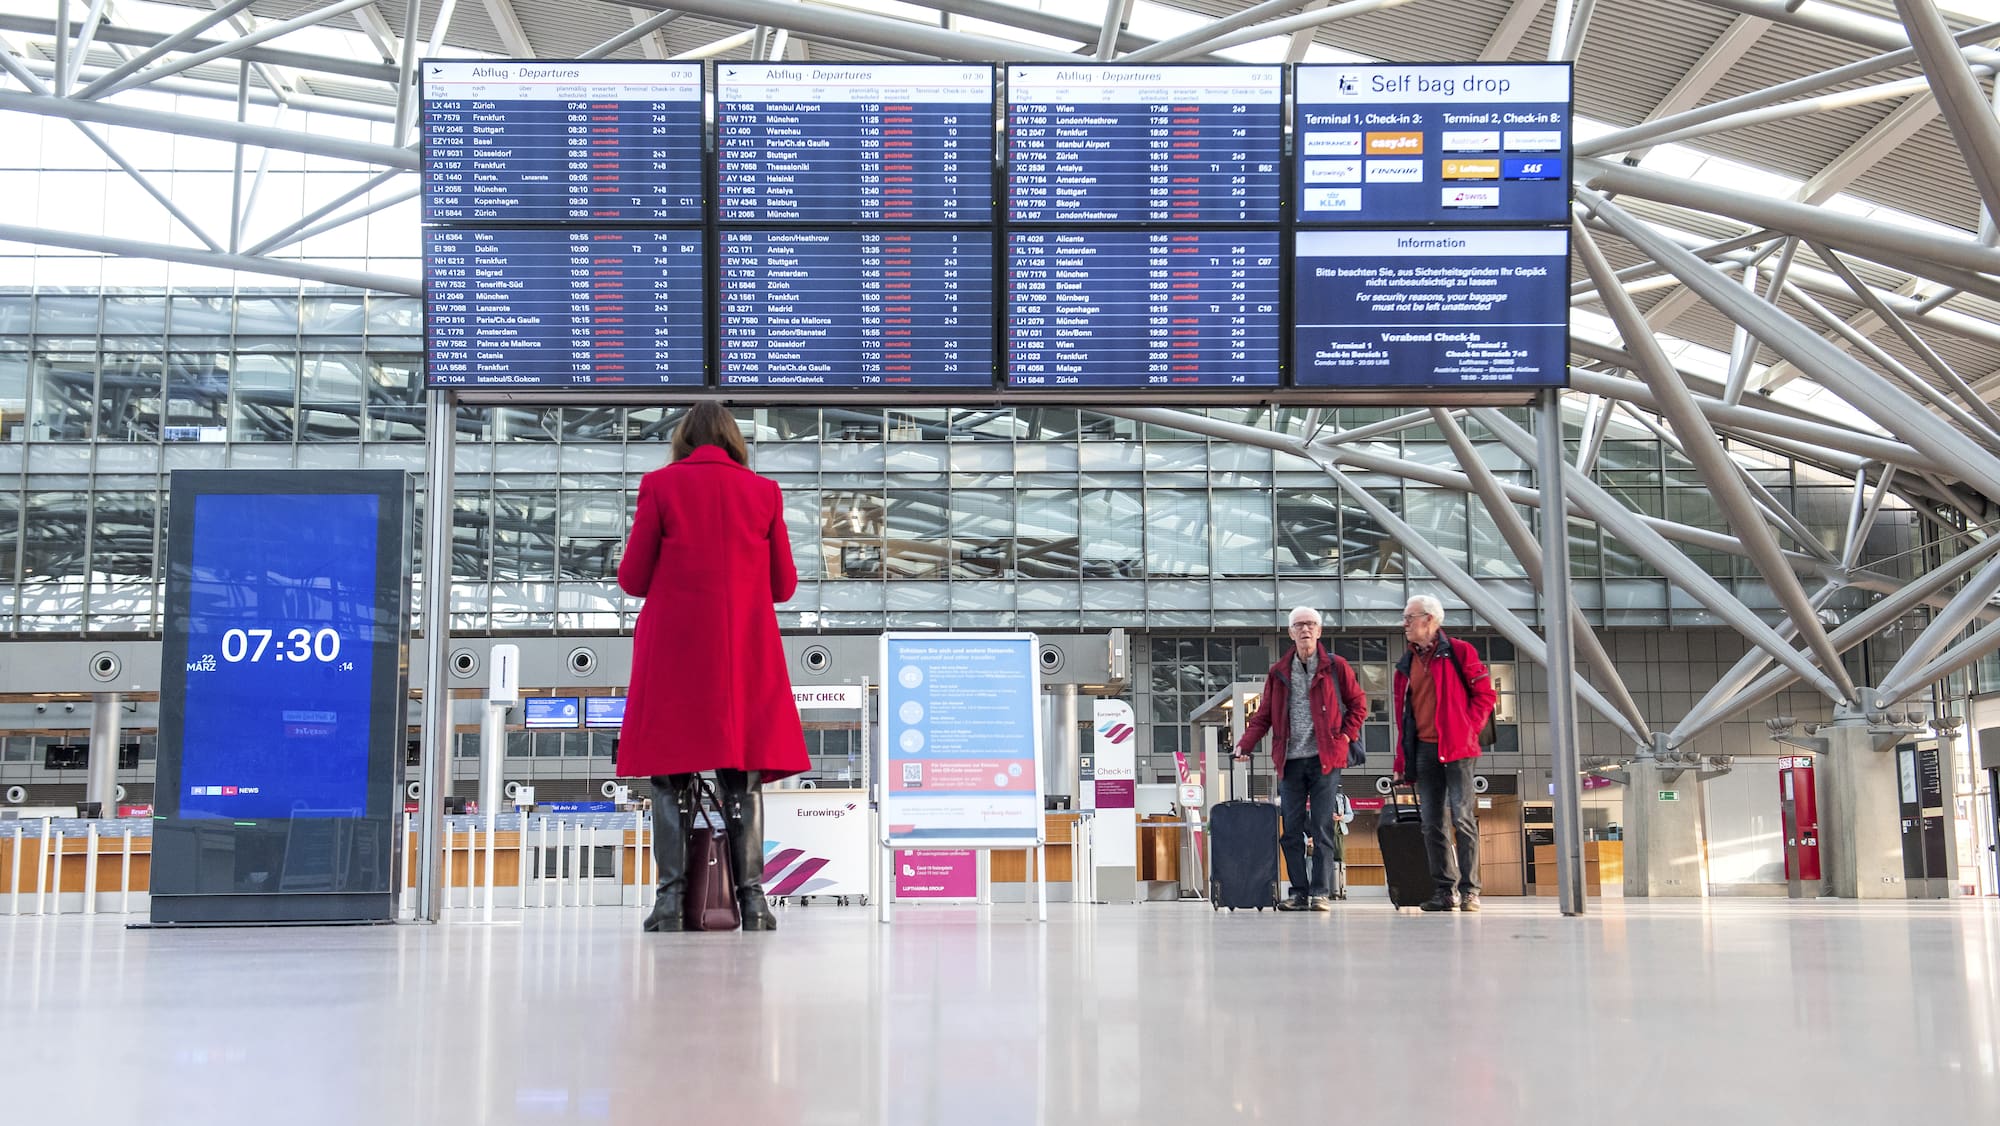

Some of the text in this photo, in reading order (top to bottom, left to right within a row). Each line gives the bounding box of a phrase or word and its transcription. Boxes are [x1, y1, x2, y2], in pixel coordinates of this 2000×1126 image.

[472, 68, 508, 79] Abflug
[520, 68, 579, 79] Departures
[767, 70, 871, 80] Abflug Departures
[1057, 72, 1091, 82] Abflug
[1103, 72, 1160, 82] Departures
[1372, 75, 1510, 96] Self bag drop
[1305, 114, 1422, 125] Terminal 1, Check-in 3:
[1443, 113, 1560, 124] Terminal 2, Check-in 8:
[473, 126, 504, 135] Stuttgart
[1372, 137, 1417, 149] easyJet
[767, 151, 797, 160] Stuttgart
[1522, 164, 1542, 172] SAS
[475, 198, 518, 206] Kopenhagen
[767, 199, 797, 208] Salzburg
[1398, 238, 1465, 247] Information
[1316, 268, 1336, 276] Bitte
[1379, 268, 1395, 276] Sie,
[1415, 268, 1499, 278] Sicherheitsgründen
[1515, 267, 1546, 277] Gepäck
[1389, 278, 1455, 287] unbeaufsichtigt
[1356, 293, 1371, 301] For
[1372, 293, 1407, 302] security
[1409, 294, 1445, 303] reasons,
[1469, 293, 1507, 302] baggage
[1056, 306, 1099, 314] Kopenhagen
[1396, 302, 1411, 311] not
[1442, 302, 1492, 310] unattended
[1382, 333, 1432, 341] Vorabend
[222, 628, 340, 662] 07:30
[187, 661, 216, 671] MÄRZ
[339, 663, 353, 671] :14
[798, 809, 844, 818] Eurowings
